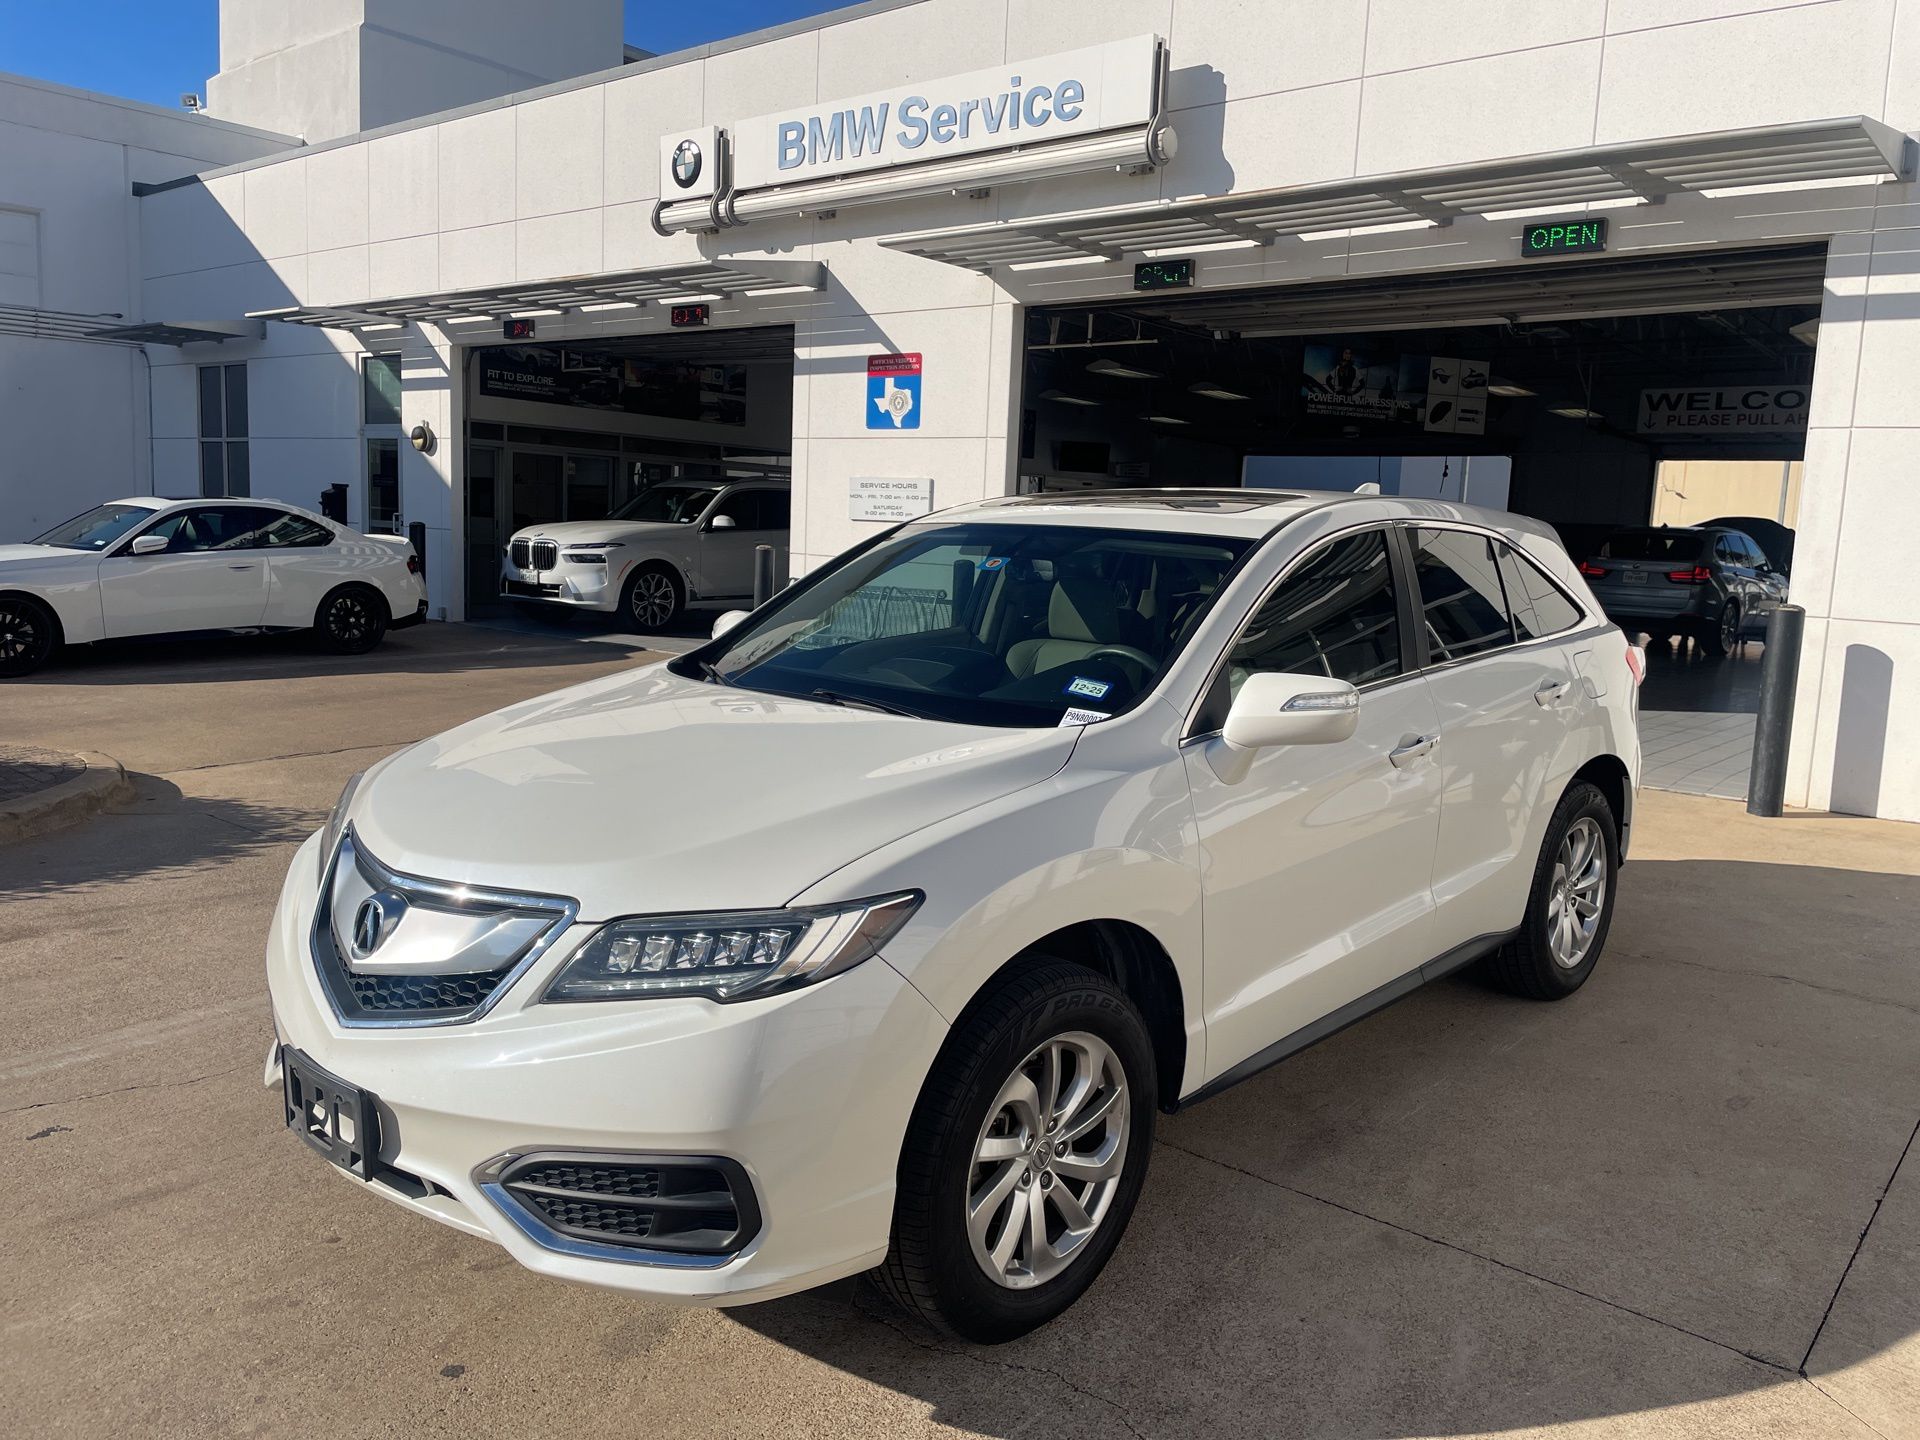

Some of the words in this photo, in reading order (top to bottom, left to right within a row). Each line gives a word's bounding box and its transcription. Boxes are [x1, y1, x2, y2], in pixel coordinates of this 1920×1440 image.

[778, 102, 890, 170] BMW
[896, 76, 1085, 149] Service
[1531, 223, 1598, 249] OPEN
[487, 368, 501, 380] FIT
[502, 371, 514, 381] TO
[1307, 392, 1354, 405] POWERFUL
[1666, 413, 1731, 426] PLEASE
[1736, 413, 1779, 426] PULL
